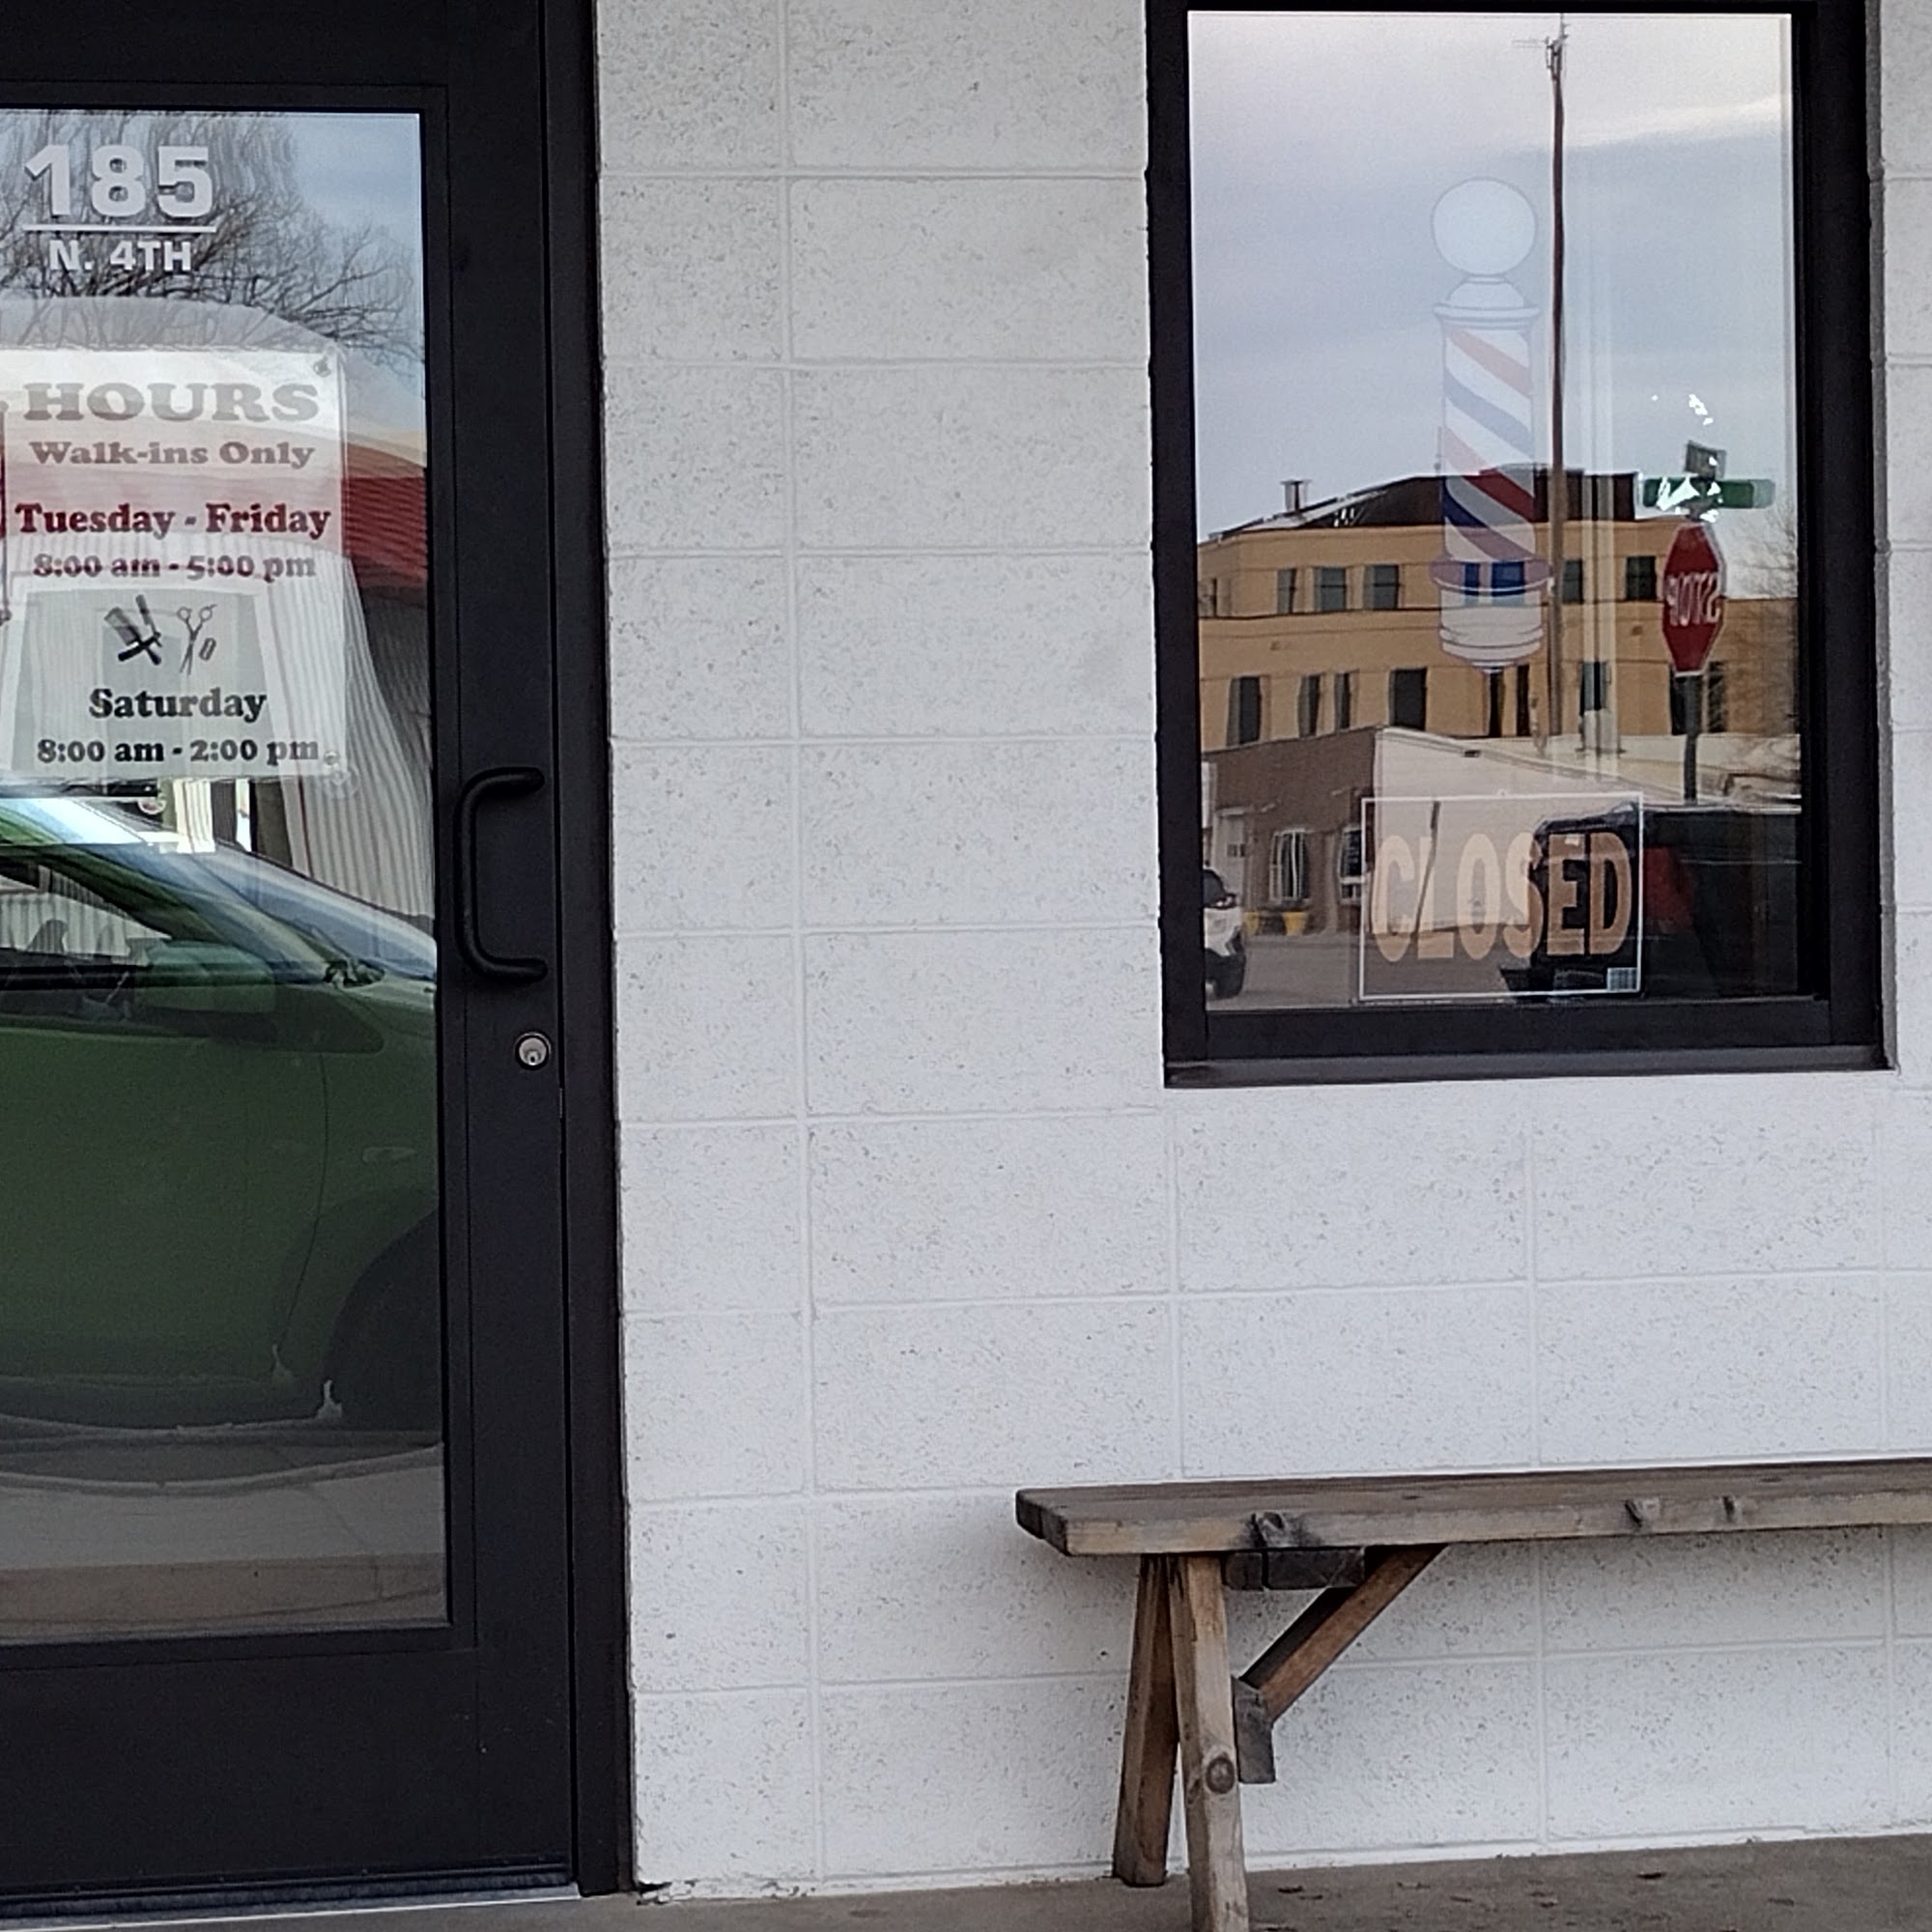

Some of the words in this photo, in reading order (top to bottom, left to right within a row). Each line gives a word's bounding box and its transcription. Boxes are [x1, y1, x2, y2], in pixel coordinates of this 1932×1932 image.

[24, 144, 213, 218] 185
[48, 240, 93, 271] N.
[110, 240, 192, 271] 4TH
[23, 383, 320, 422] HOURS
[29, 441, 209, 465] Walk-ins
[219, 441, 316, 469] Only
[14, 502, 176, 540] Tuesday
[205, 502, 332, 540] Friday
[33, 554, 103, 578] 8:00
[111, 557, 160, 578] am
[186, 554, 255, 581] 5:00
[263, 556, 317, 583] pm
[89, 687, 268, 724] Saturday
[38, 739, 106, 763] 8:00
[114, 741, 164, 762] am
[190, 739, 259, 761] 2:00
[267, 740, 319, 766] pm
[1371, 832, 1633, 962] CLOSED
